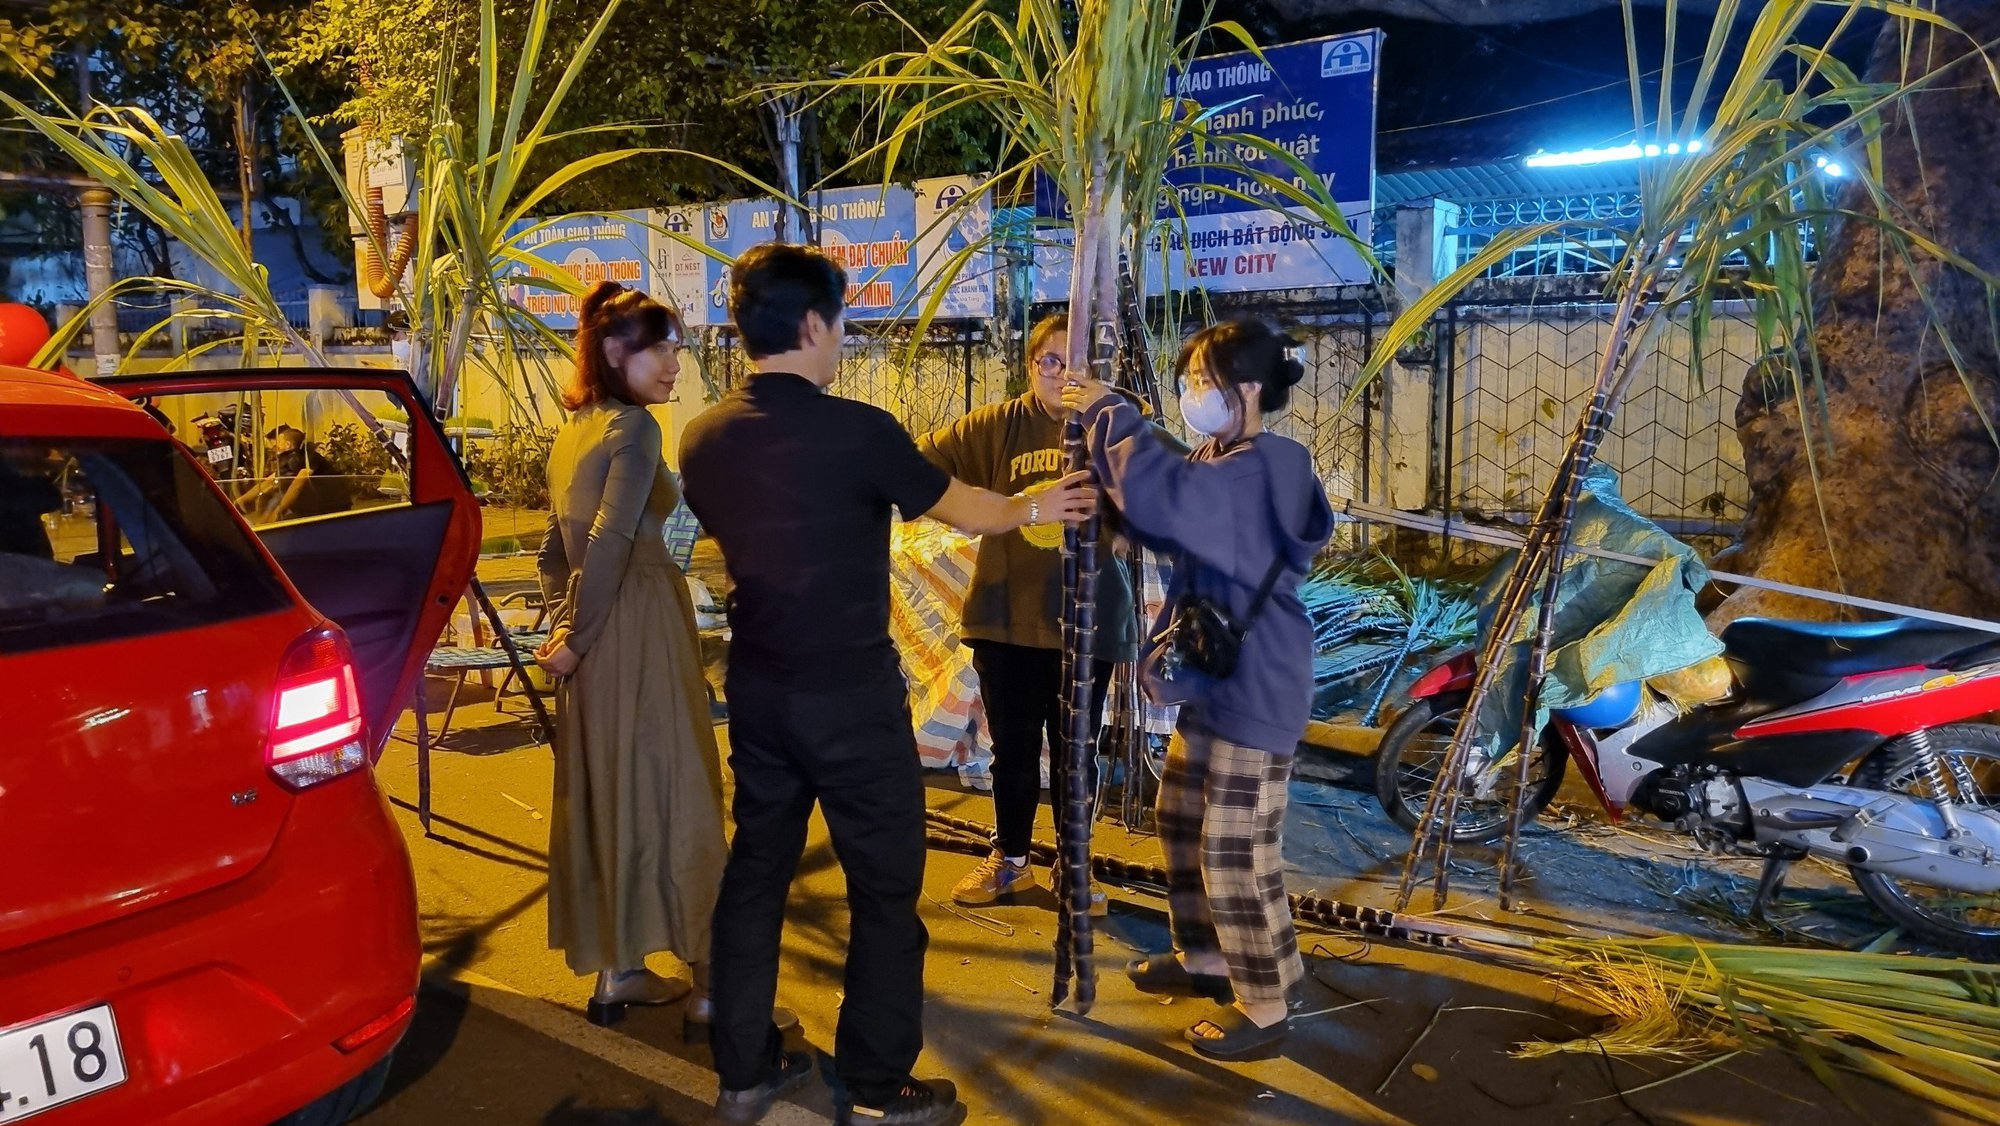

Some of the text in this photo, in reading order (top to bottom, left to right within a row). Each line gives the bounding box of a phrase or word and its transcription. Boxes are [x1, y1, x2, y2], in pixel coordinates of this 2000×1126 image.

[1217, 61, 1271, 88] THÔNG
[1262, 97, 1325, 129] phúc,
[752, 213, 769, 228] AN
[841, 198, 886, 220] THÔNG
[524, 233, 538, 245] AN
[567, 226, 590, 242] GIAO
[592, 222, 626, 241] THÔNG
[1191, 229, 1228, 252] DỊCH
[1233, 220, 1265, 246] BẤT
[1268, 220, 1316, 246] ĐỘNG
[849, 243, 869, 272] ĐẠT
[871, 230, 909, 267] CHUẨN
[1234, 253, 1277, 276] CITY
[585, 262, 606, 282] GIAO
[608, 256, 641, 281] THÔNG
[685, 262, 700, 271] NEST
[526, 290, 551, 318] TRIỆU
[553, 293, 567, 317] NỤ
[0, 1020, 107, 1112] .18
